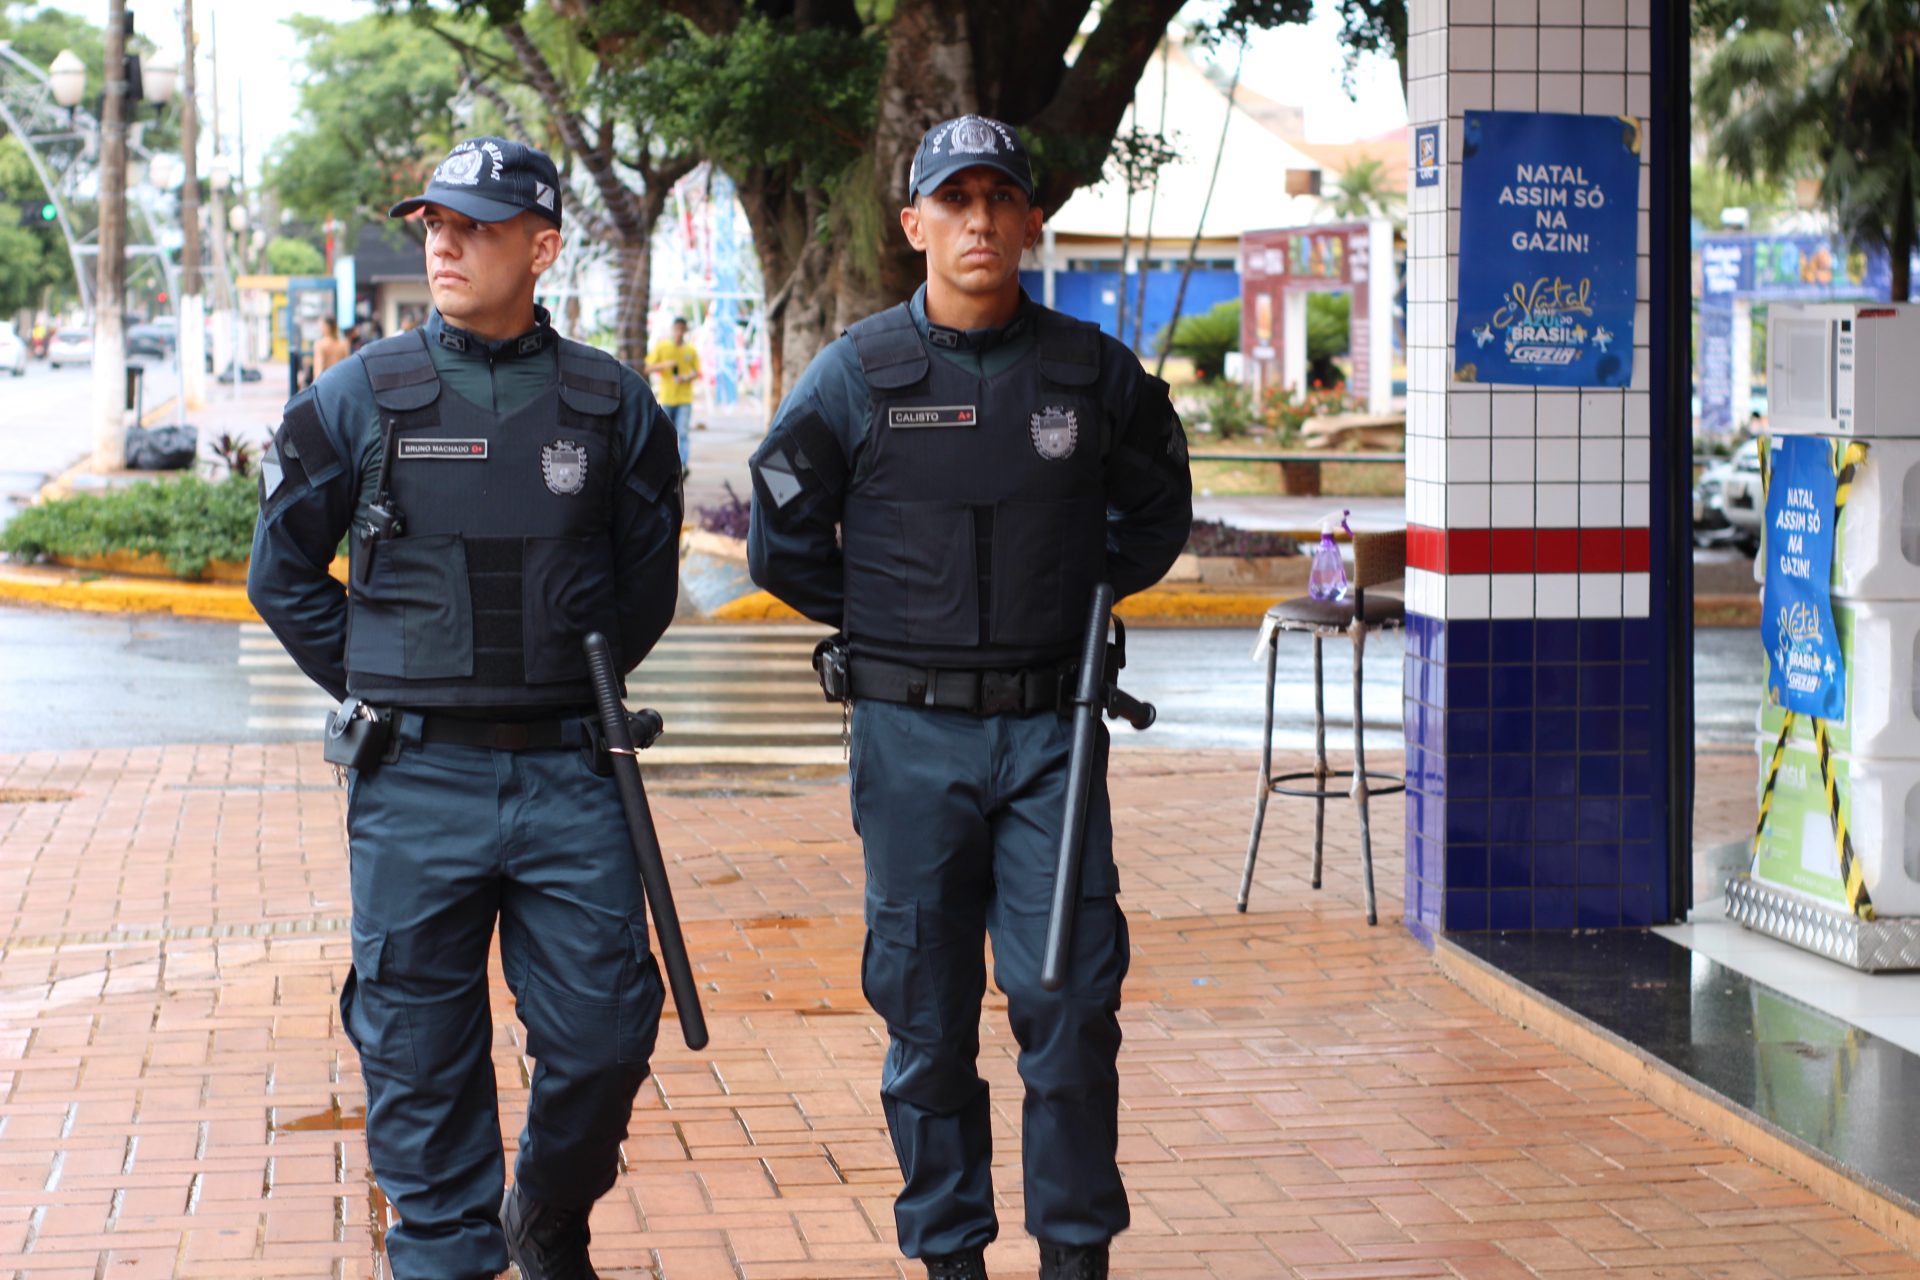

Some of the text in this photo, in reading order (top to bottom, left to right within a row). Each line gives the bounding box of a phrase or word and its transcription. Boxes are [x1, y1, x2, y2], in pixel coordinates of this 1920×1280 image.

[1517, 164, 1588, 185] NATAL
[1498, 184, 1604, 208] ASSIM SÓ
[1536, 209, 1567, 229] NA
[1512, 231, 1589, 253] GAZIN!
[1512, 276, 1593, 318] Natal
[1511, 326, 1577, 344] BRASIL
[1511, 346, 1576, 365] GAZIN
[896, 411, 972, 423] CALISTO A+
[405, 445, 431, 453] BRUNO
[433, 445, 469, 454] MACHADO
[1787, 487, 1815, 510] NATAL
[1775, 508, 1820, 534] ASSIM SÓ
[1787, 533, 1803, 554] NA
[1780, 555, 1810, 579] GAZIN!
